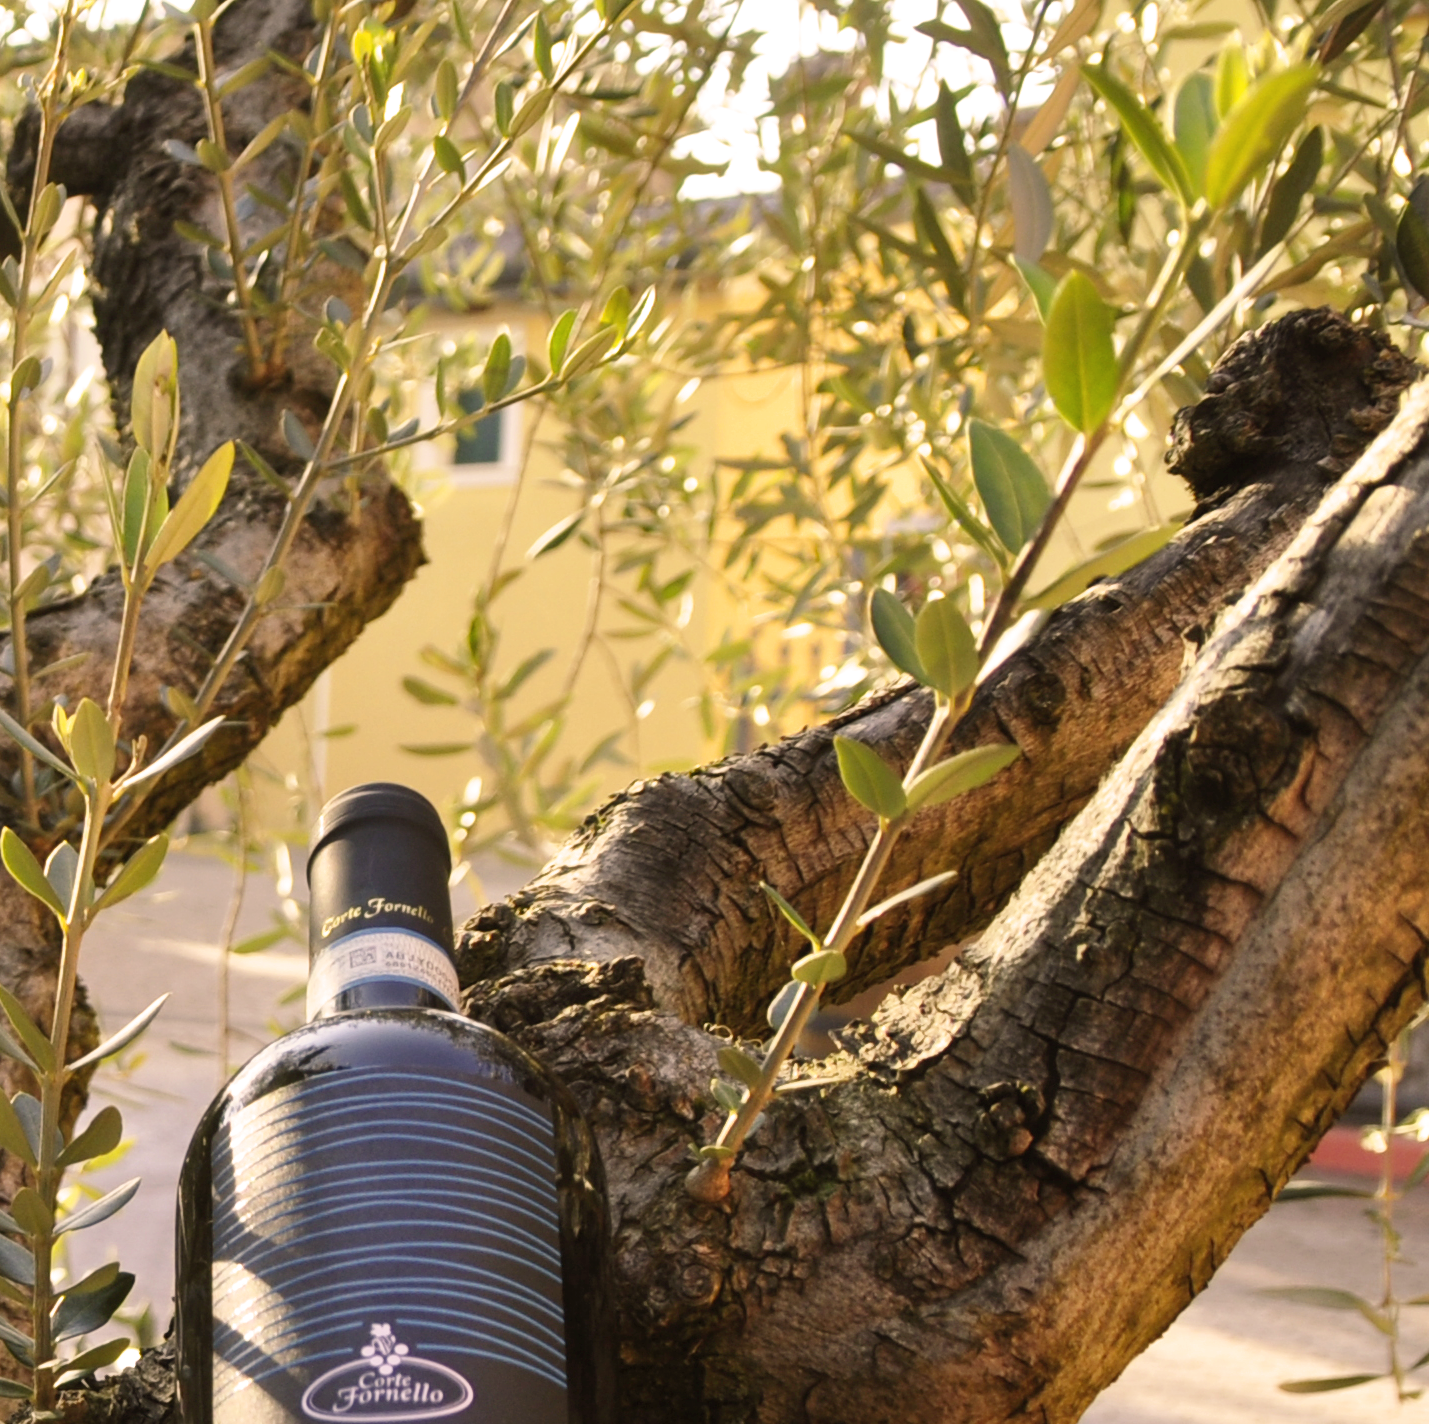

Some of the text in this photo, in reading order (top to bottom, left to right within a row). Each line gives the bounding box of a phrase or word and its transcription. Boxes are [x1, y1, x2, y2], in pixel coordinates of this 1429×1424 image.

[321, 898, 434, 938] Corte Fornello
[359, 1371, 411, 1389] Corte
[332, 1382, 444, 1413] Fornello
